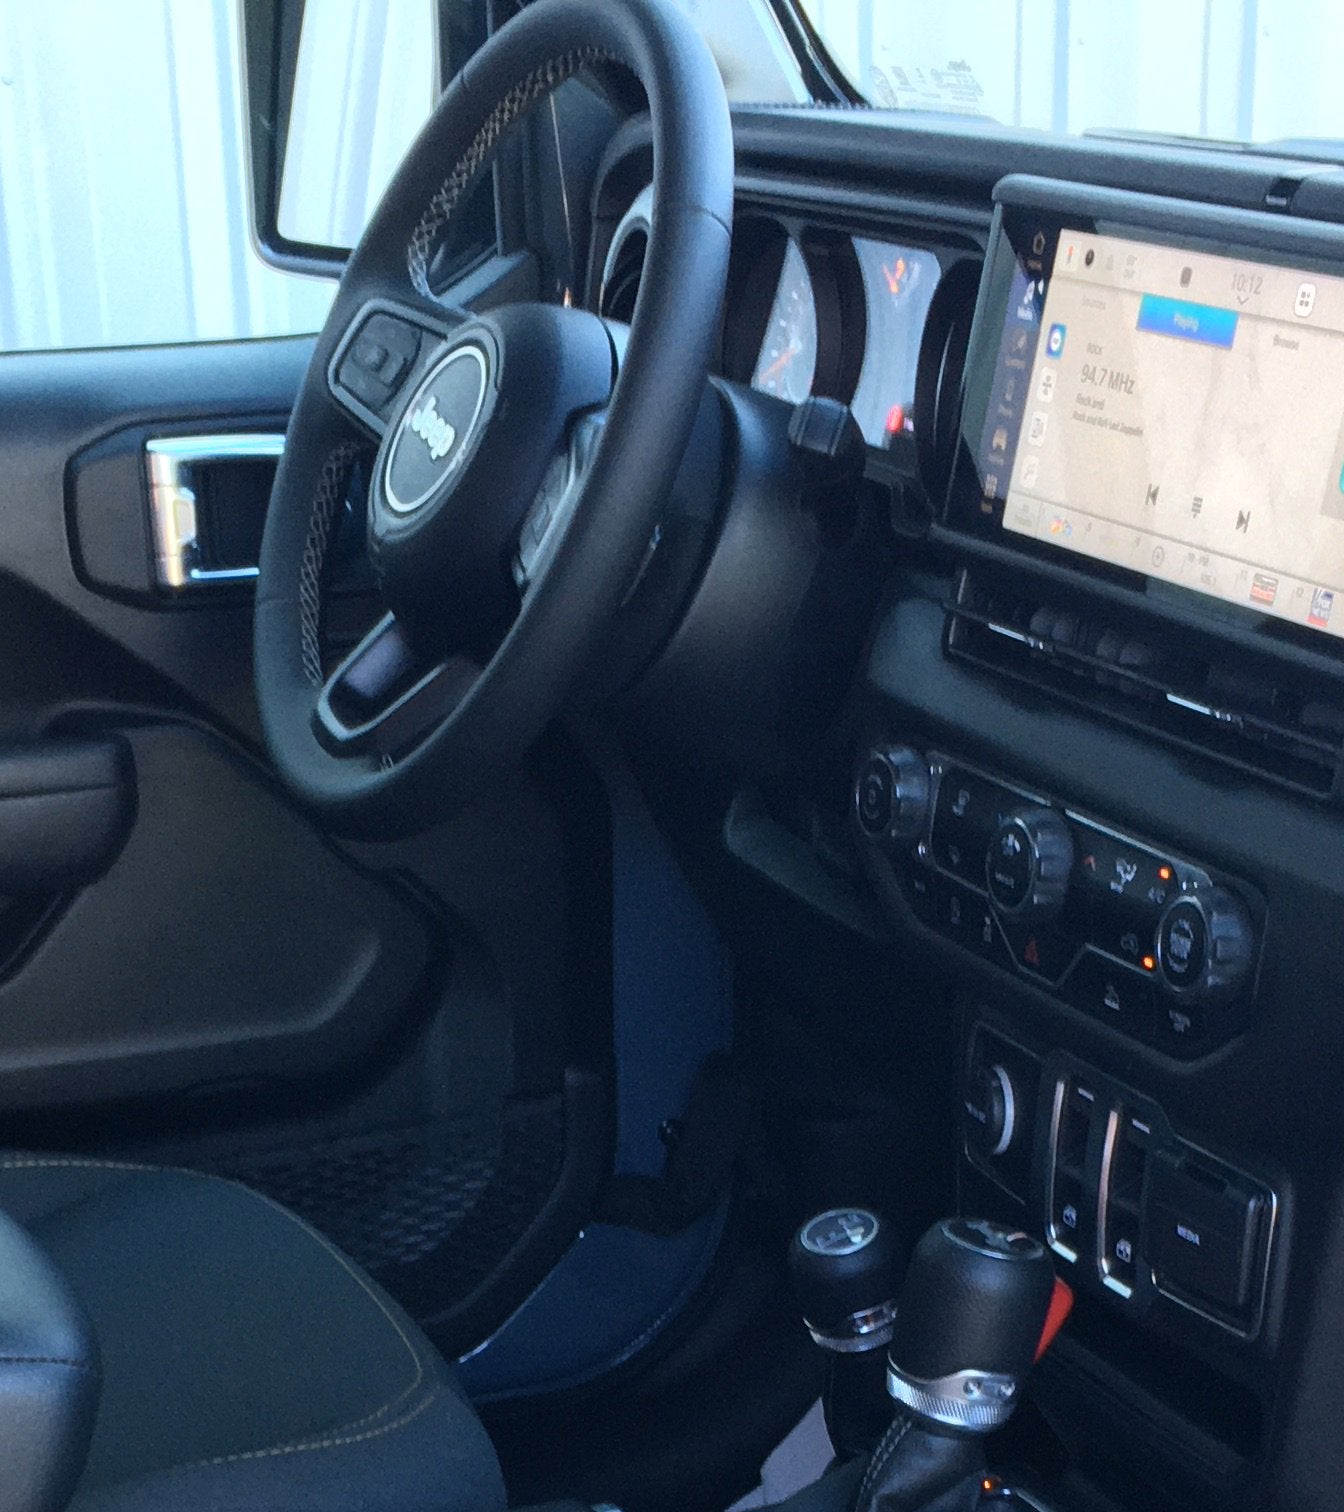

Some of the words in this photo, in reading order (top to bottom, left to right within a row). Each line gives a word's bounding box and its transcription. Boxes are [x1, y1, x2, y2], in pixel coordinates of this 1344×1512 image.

[1230, 272, 1265, 296] 10:12
[1080, 364, 1108, 389] 94.7
[1107, 370, 1136, 395] MHz
